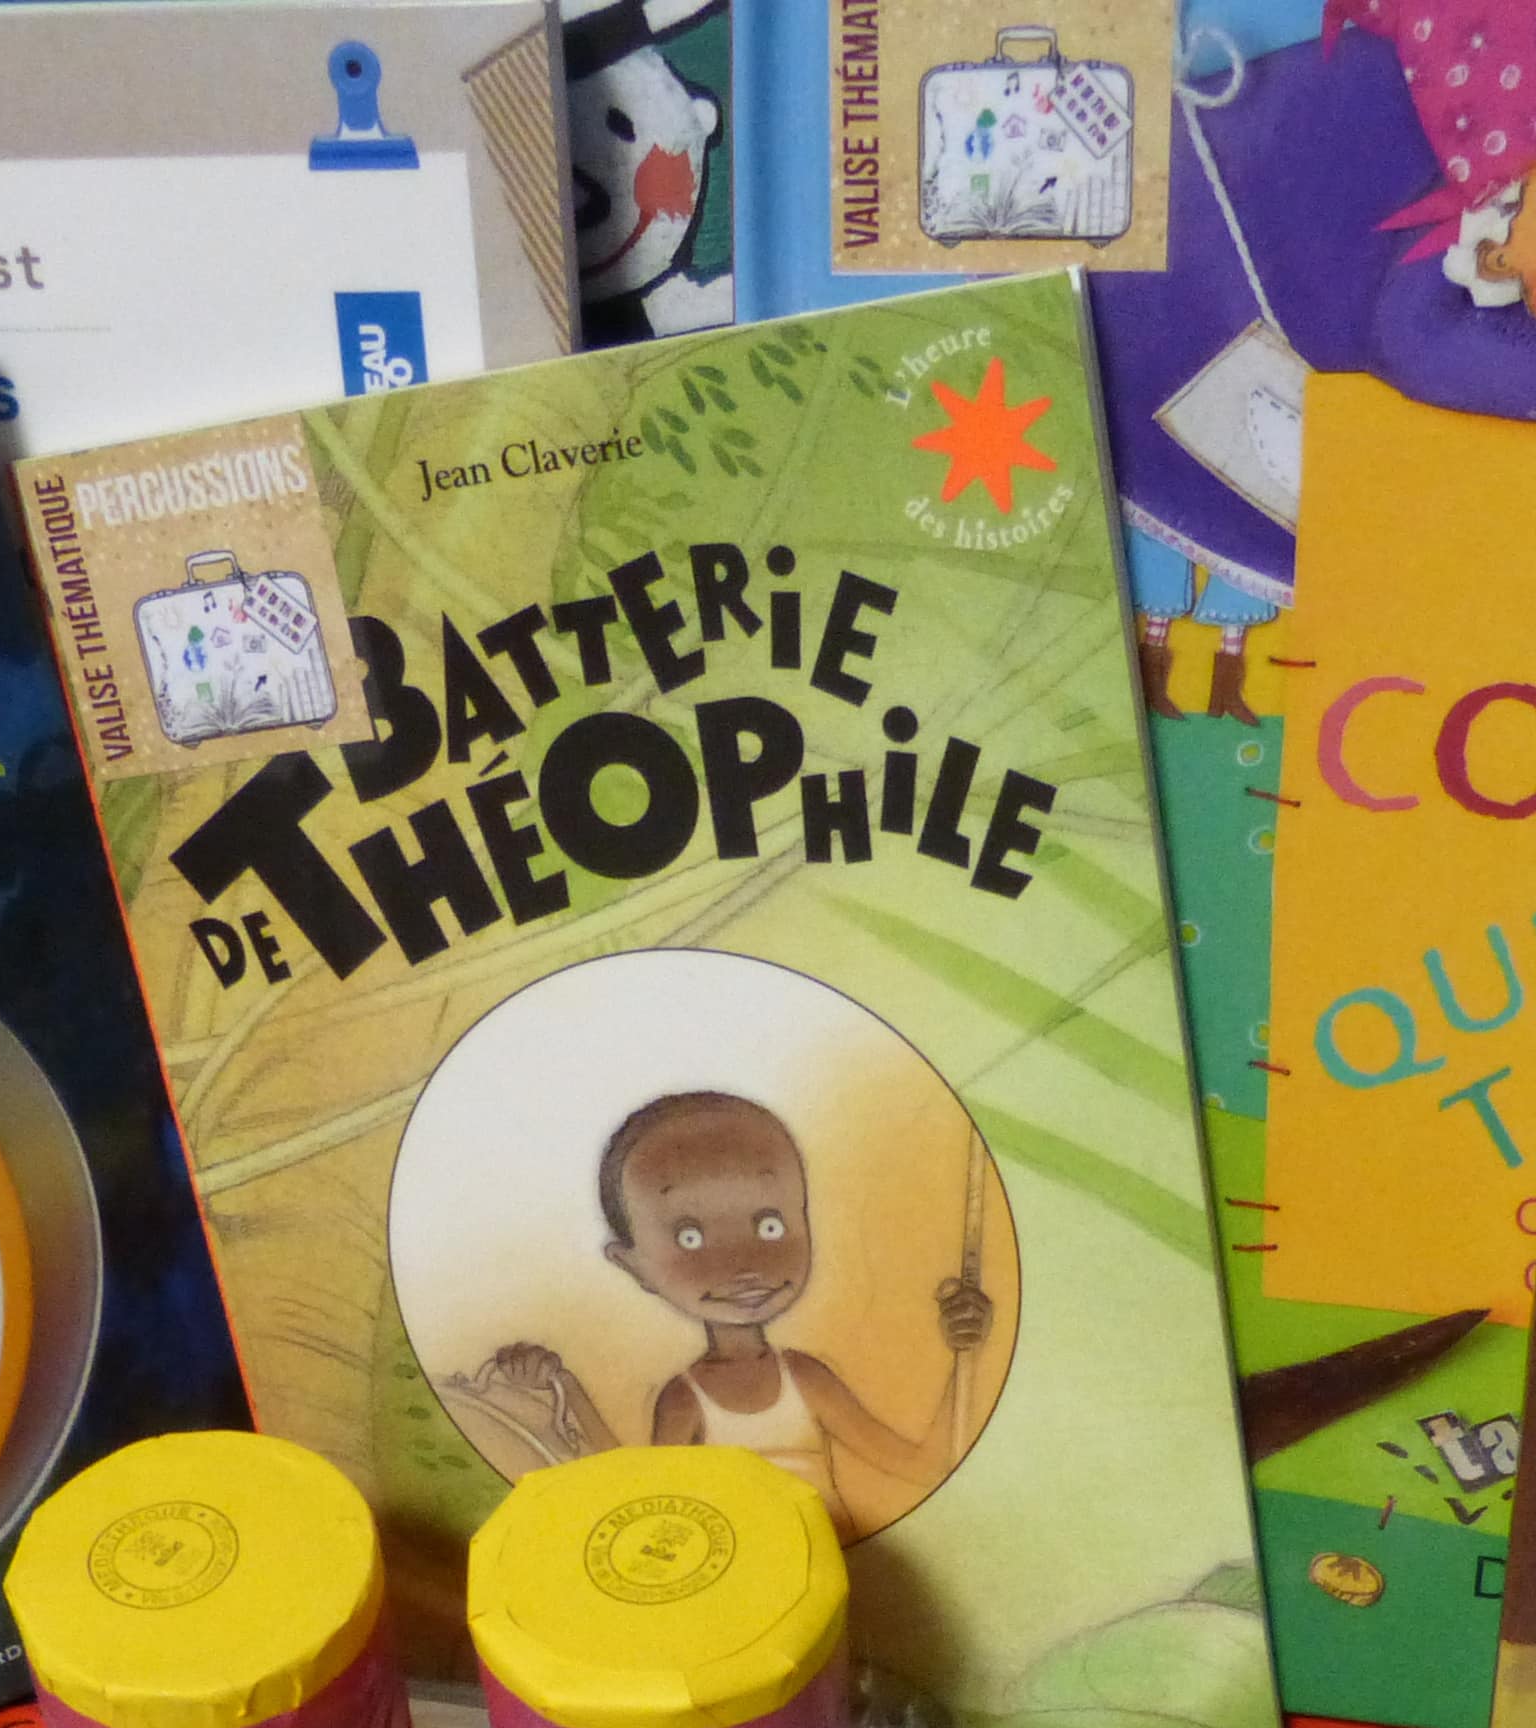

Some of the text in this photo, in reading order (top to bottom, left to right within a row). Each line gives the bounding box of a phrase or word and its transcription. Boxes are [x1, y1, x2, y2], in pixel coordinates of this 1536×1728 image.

[843, 136, 881, 249] VALISE
[885, 325, 992, 410] L'heure
[77, 443, 308, 530] PERCUSSIONS
[416, 428, 644, 501] Jean Claverie
[903, 483, 1075, 552] des histoires
[34, 474, 133, 763] VALISE THÉMATIQUE
[189, 912, 290, 991] DE
